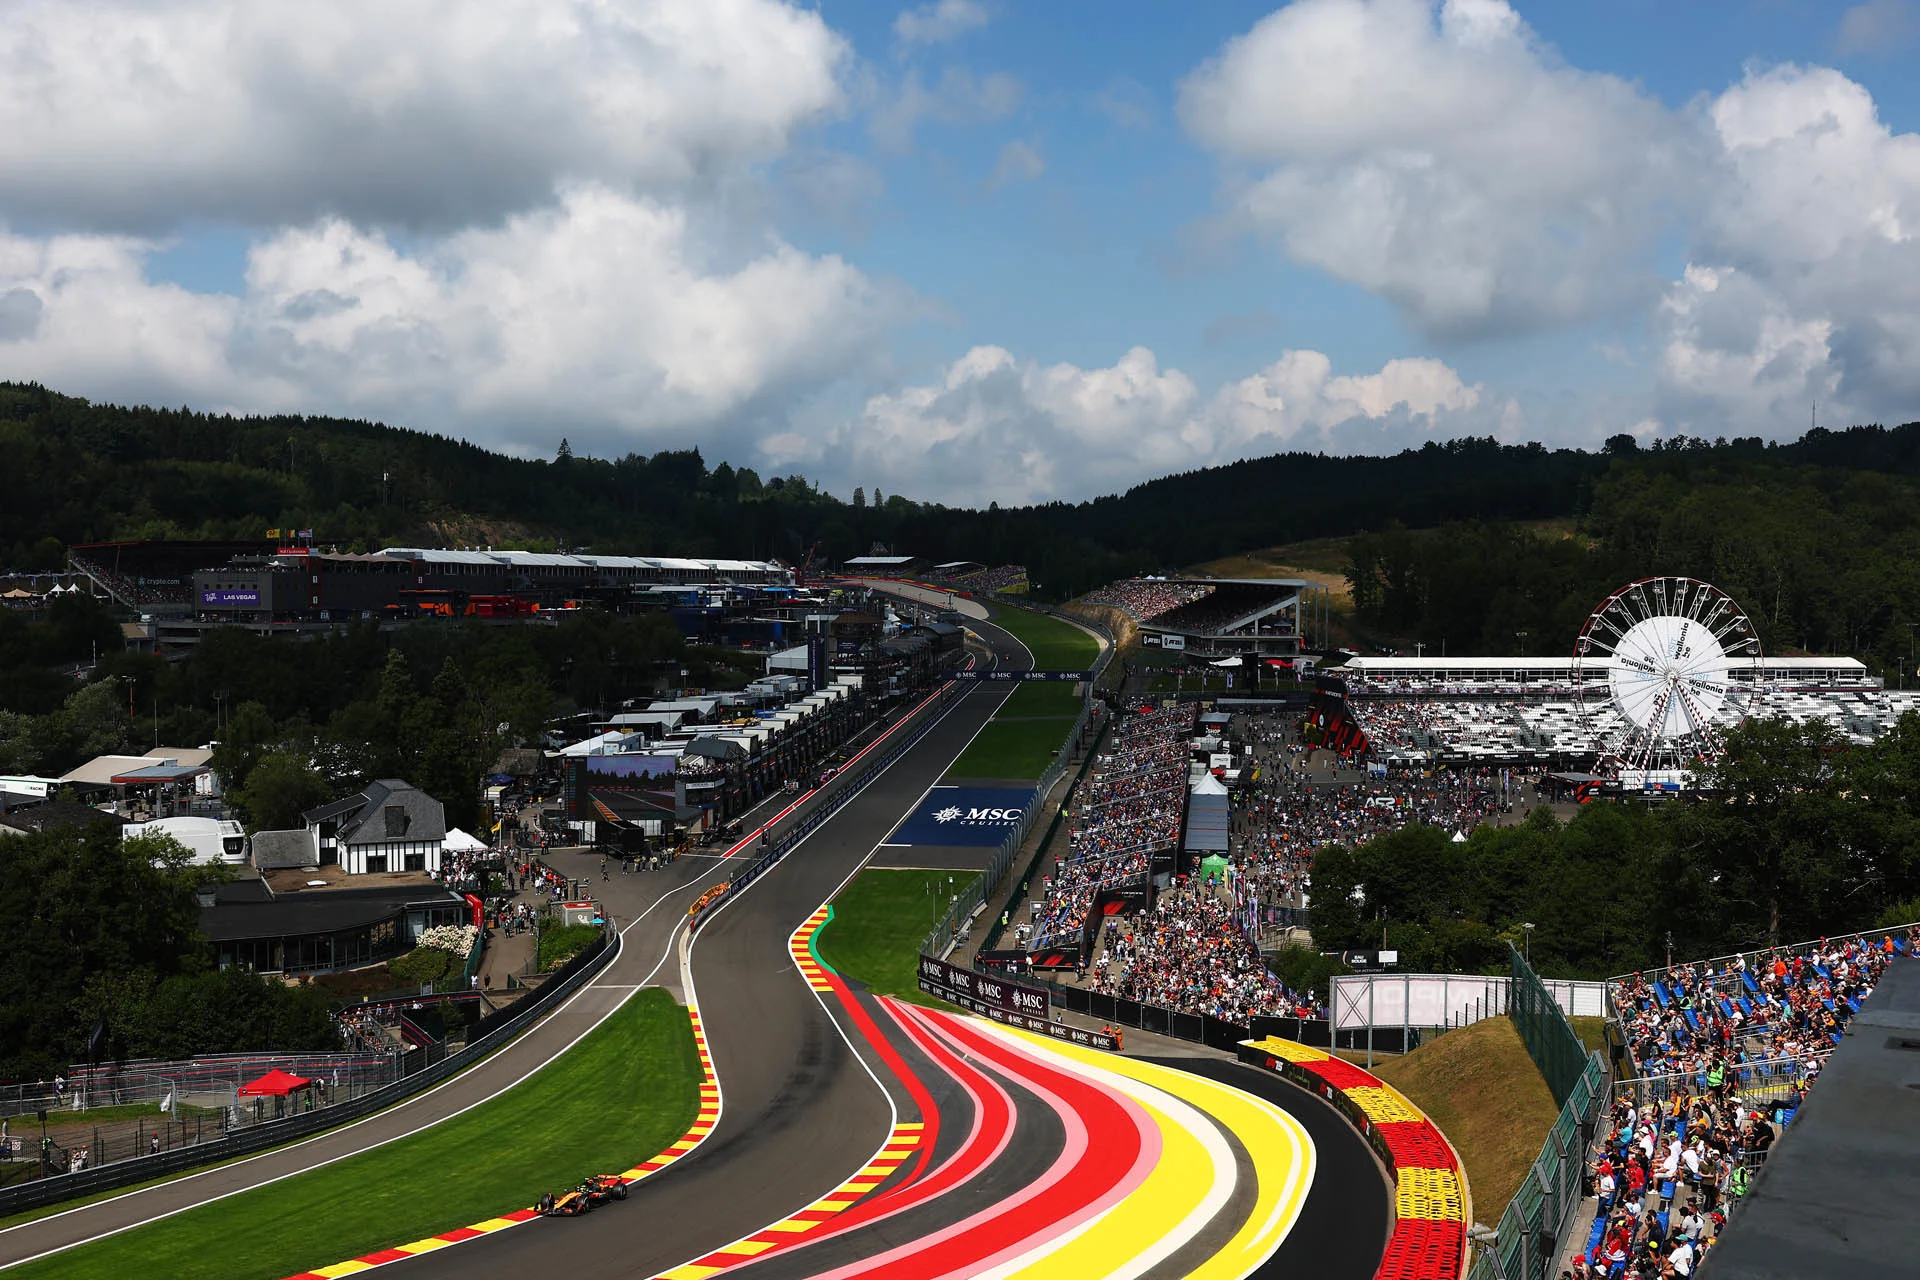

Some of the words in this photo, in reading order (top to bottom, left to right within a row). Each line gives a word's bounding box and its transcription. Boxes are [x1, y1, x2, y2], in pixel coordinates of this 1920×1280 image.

[1675, 622, 1689, 659] wallonia
[1621, 658, 1656, 673] wallonia
[1688, 678, 1723, 694] wallonia
[964, 808, 1022, 820] MSC
[928, 962, 942, 978] MSC
[955, 973, 970, 988] MSC
[984, 983, 1002, 999] MSC
[1022, 993, 1043, 1009] MSC
[1033, 1021, 1043, 1029] MSC
[1055, 1027, 1066, 1035] MSC
[1076, 1032, 1088, 1042] MSC
[1097, 1037, 1110, 1046] MSC
